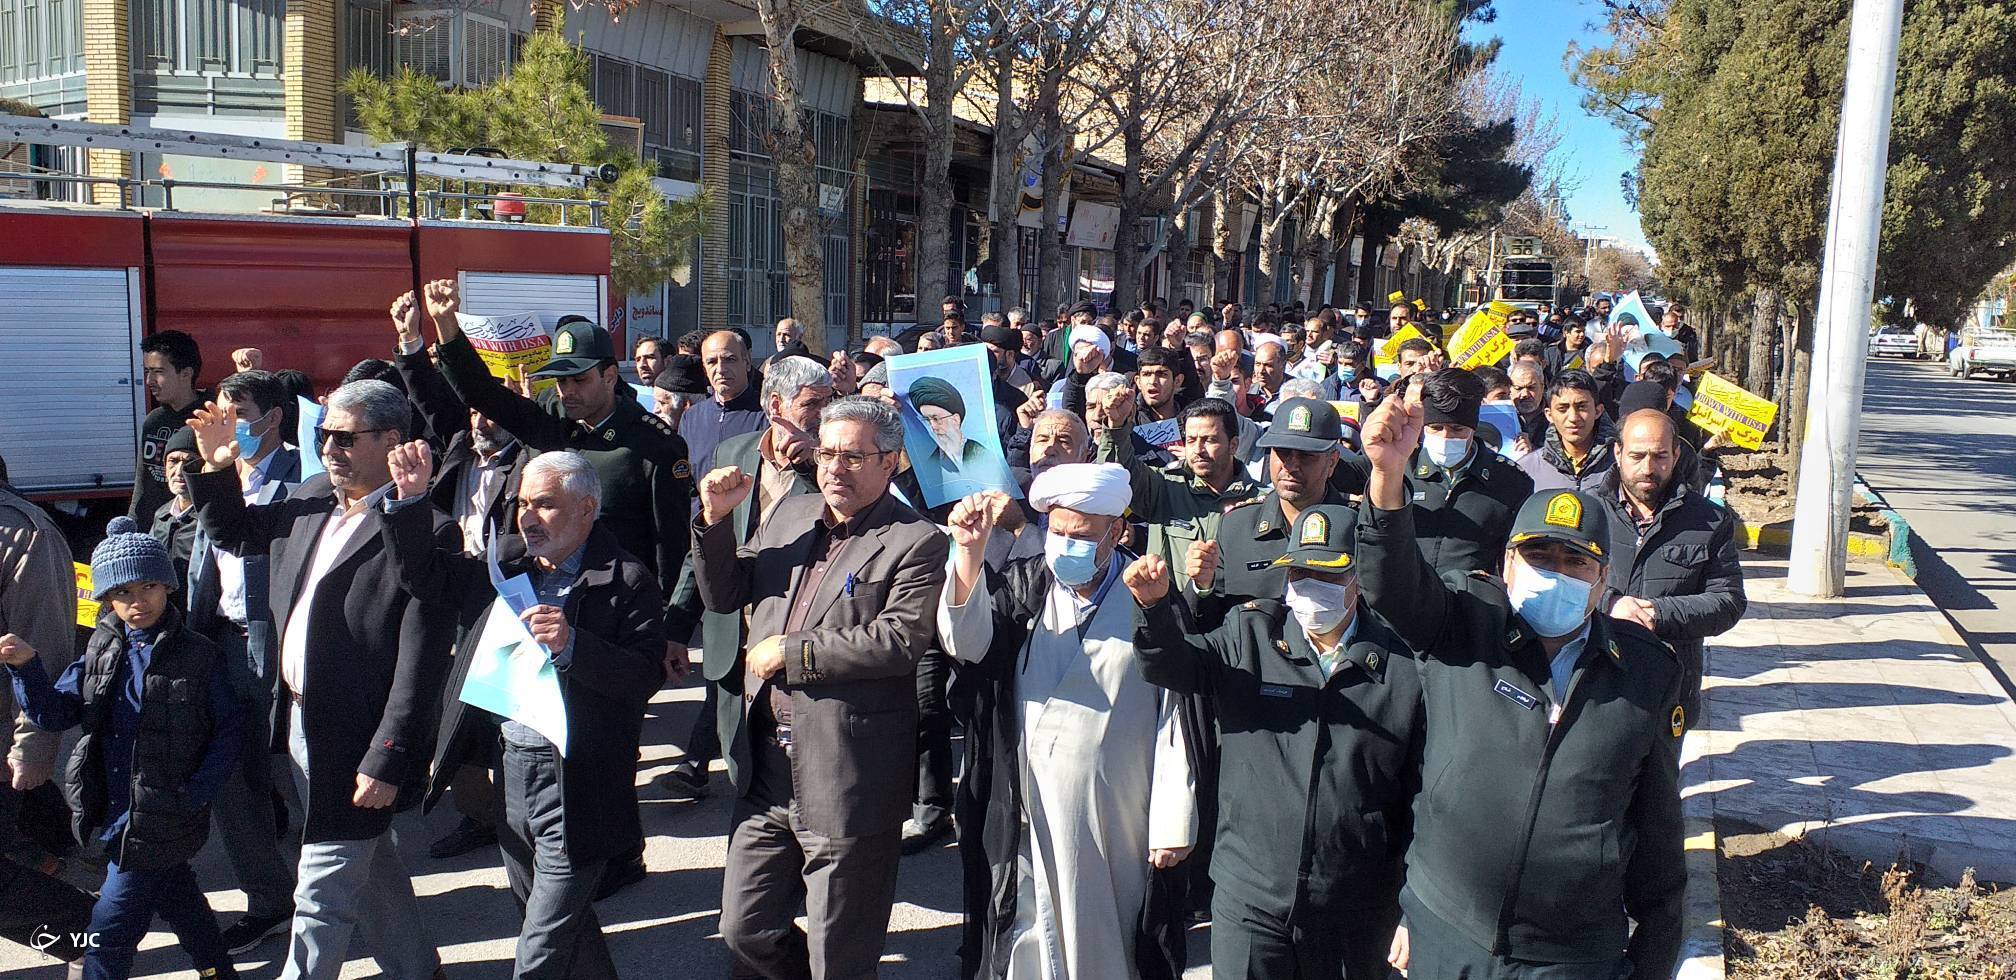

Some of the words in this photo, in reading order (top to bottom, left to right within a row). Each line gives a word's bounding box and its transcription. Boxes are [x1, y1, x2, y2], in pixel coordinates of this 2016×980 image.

[1484, 329, 1498, 341] USA
[490, 340, 518, 353] WITH
[520, 339, 546, 350] USA
[1699, 393, 1720, 412] DOWN
[1724, 406, 1744, 423] WITH
[1746, 417, 1763, 431] USA
